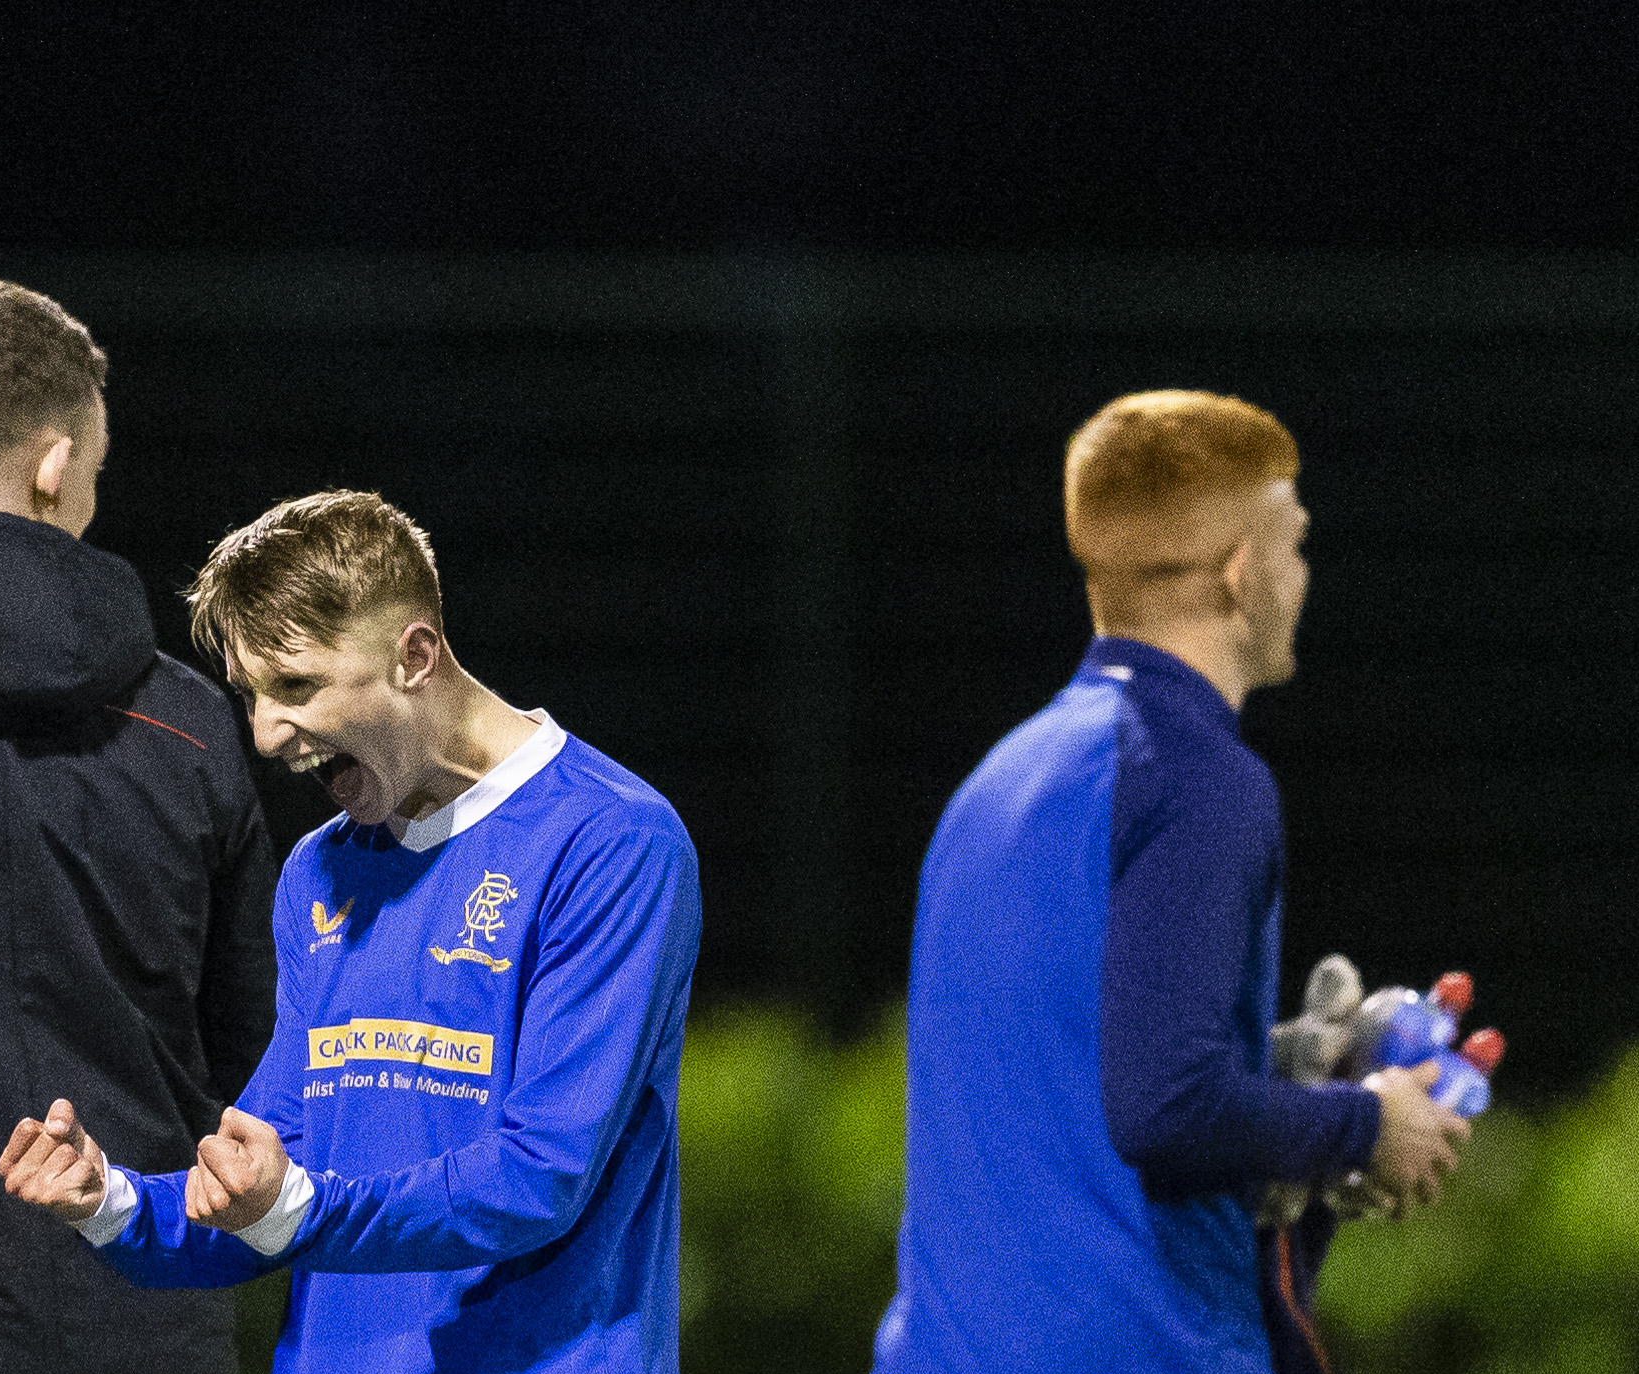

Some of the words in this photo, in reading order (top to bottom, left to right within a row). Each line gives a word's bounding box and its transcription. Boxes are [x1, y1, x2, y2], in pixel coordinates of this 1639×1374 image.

[375, 1031, 481, 1064] PACKAGING
[377, 1070, 390, 1089] &
[416, 1076, 489, 1105] Moulding
